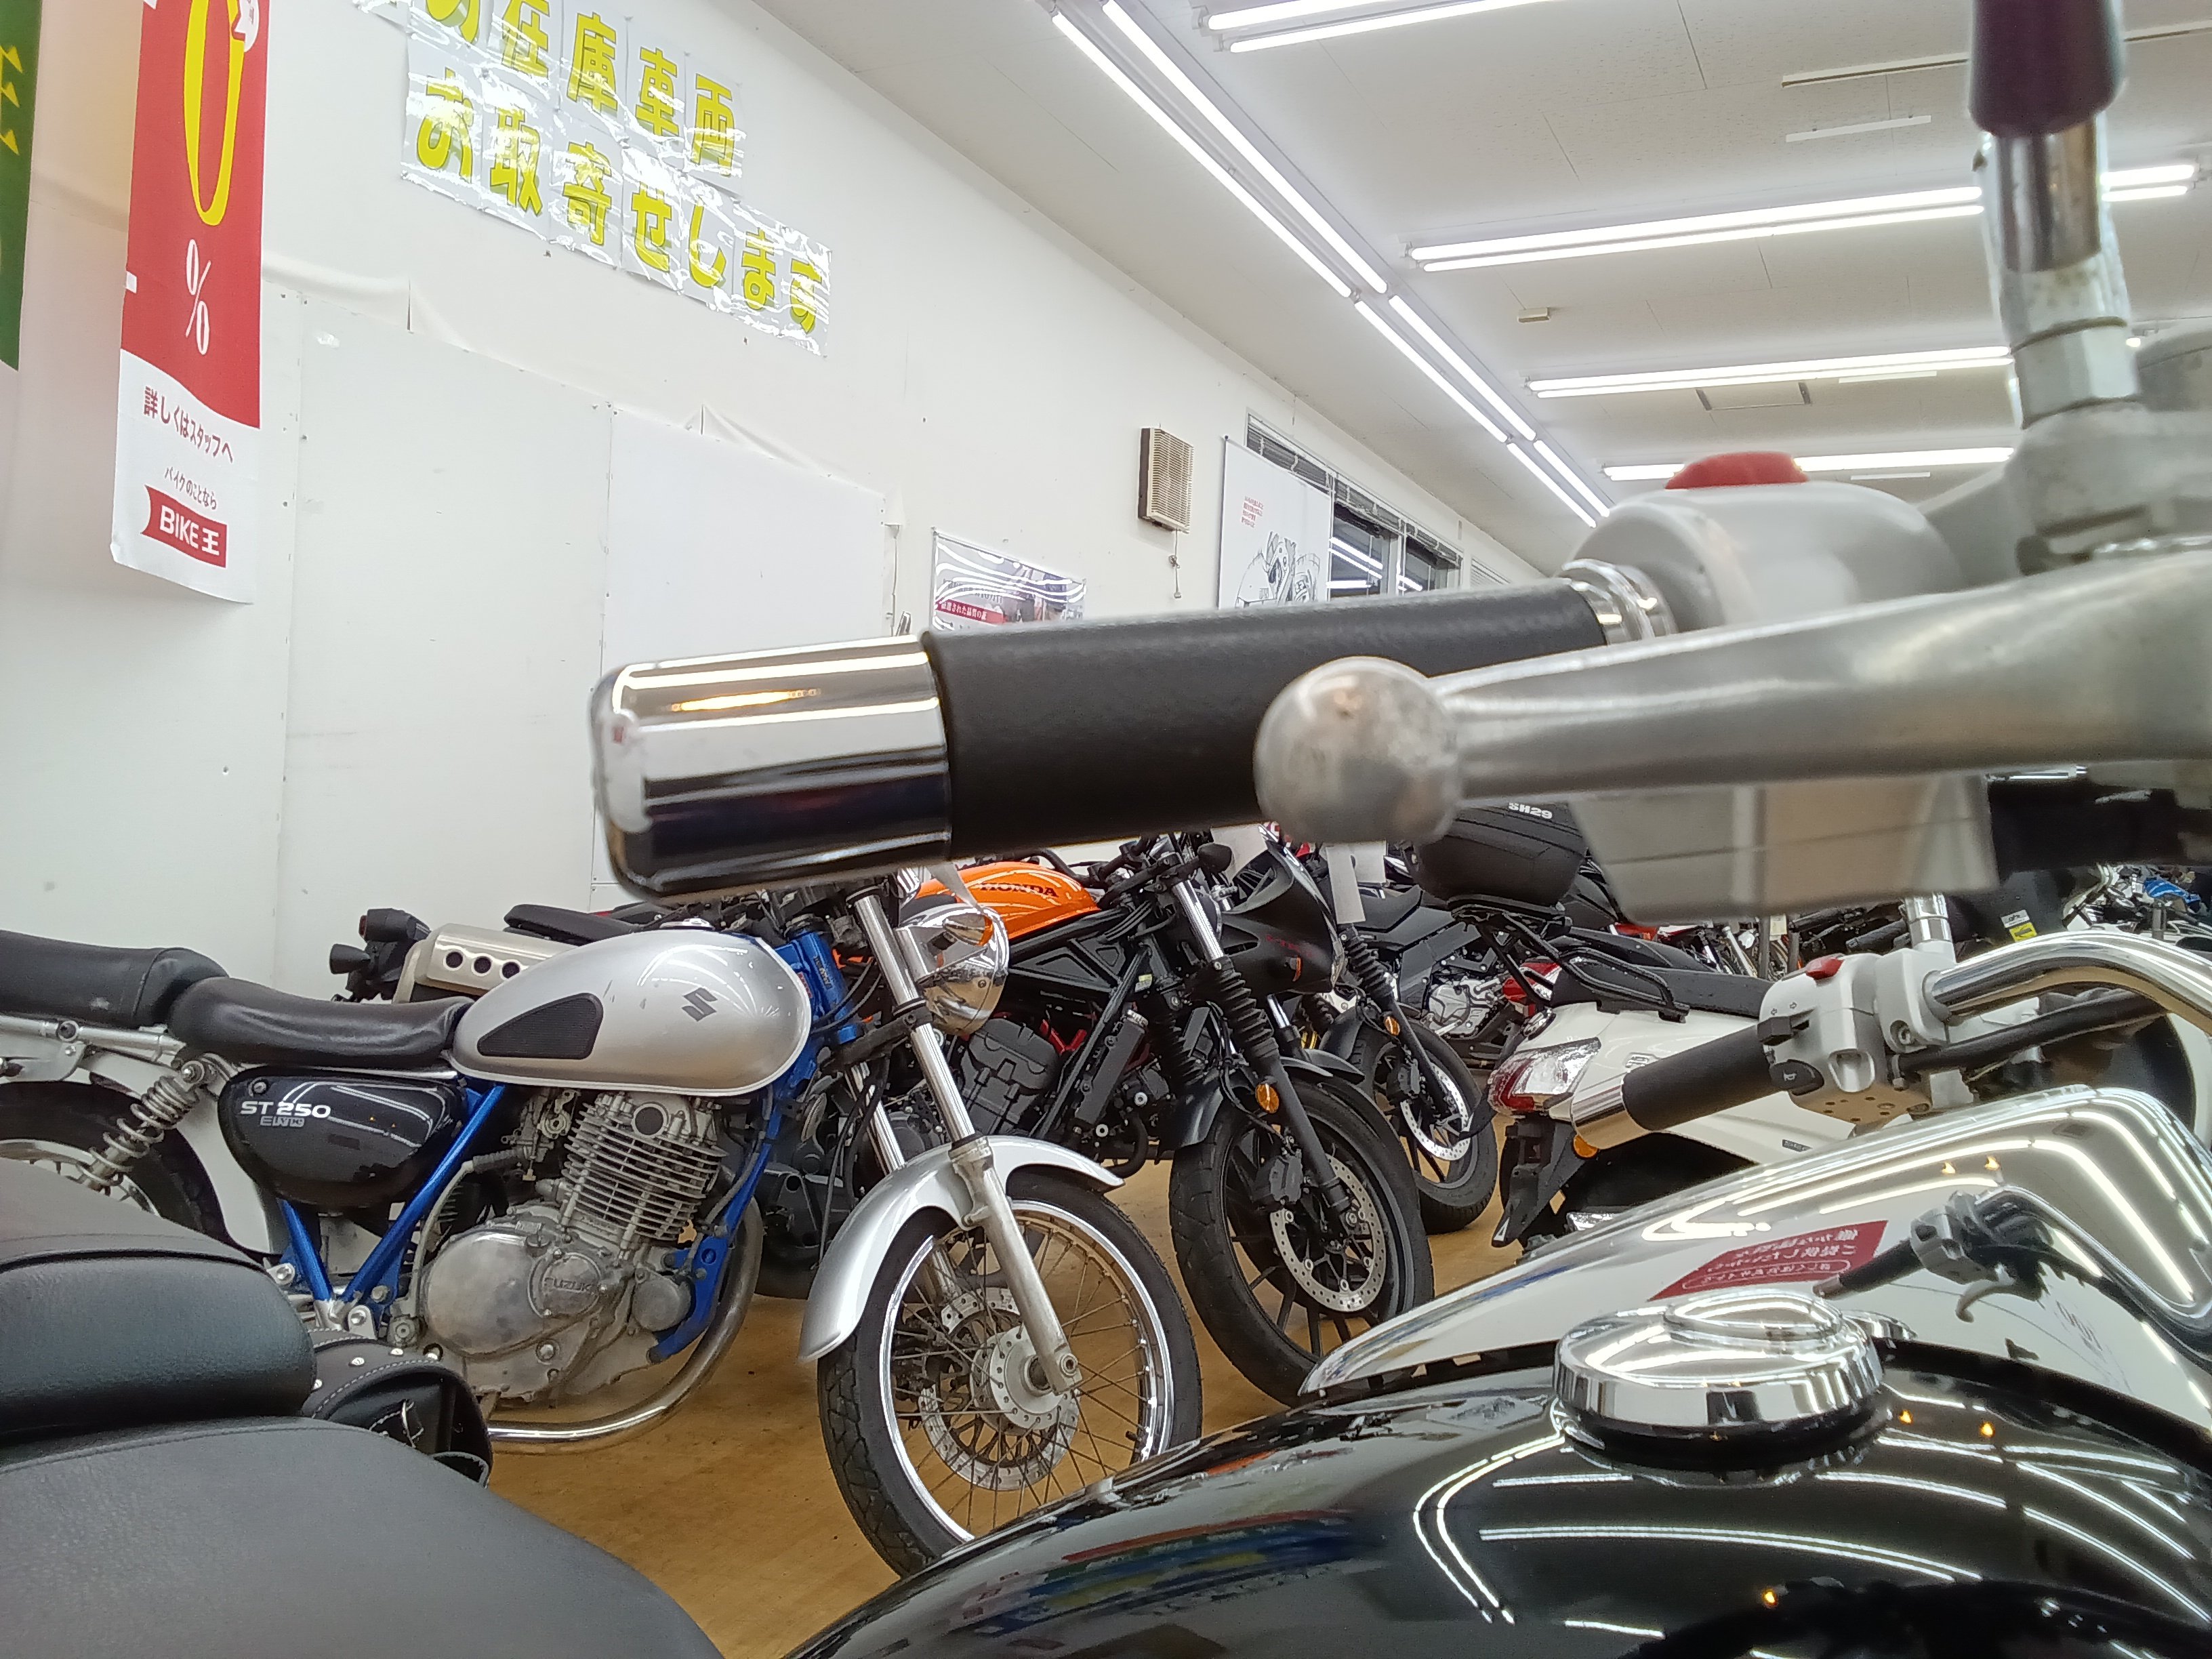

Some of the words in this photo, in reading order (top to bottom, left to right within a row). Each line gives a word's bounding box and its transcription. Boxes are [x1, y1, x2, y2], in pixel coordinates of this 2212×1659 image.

[417, 66, 823, 335] お取寄せします
[143, 385, 234, 464] 詳しくはスタッフへ
[163, 466, 218, 510] バイクのことなら
[1508, 802, 1553, 819] SH29
[980, 882, 1059, 899] HONDA
